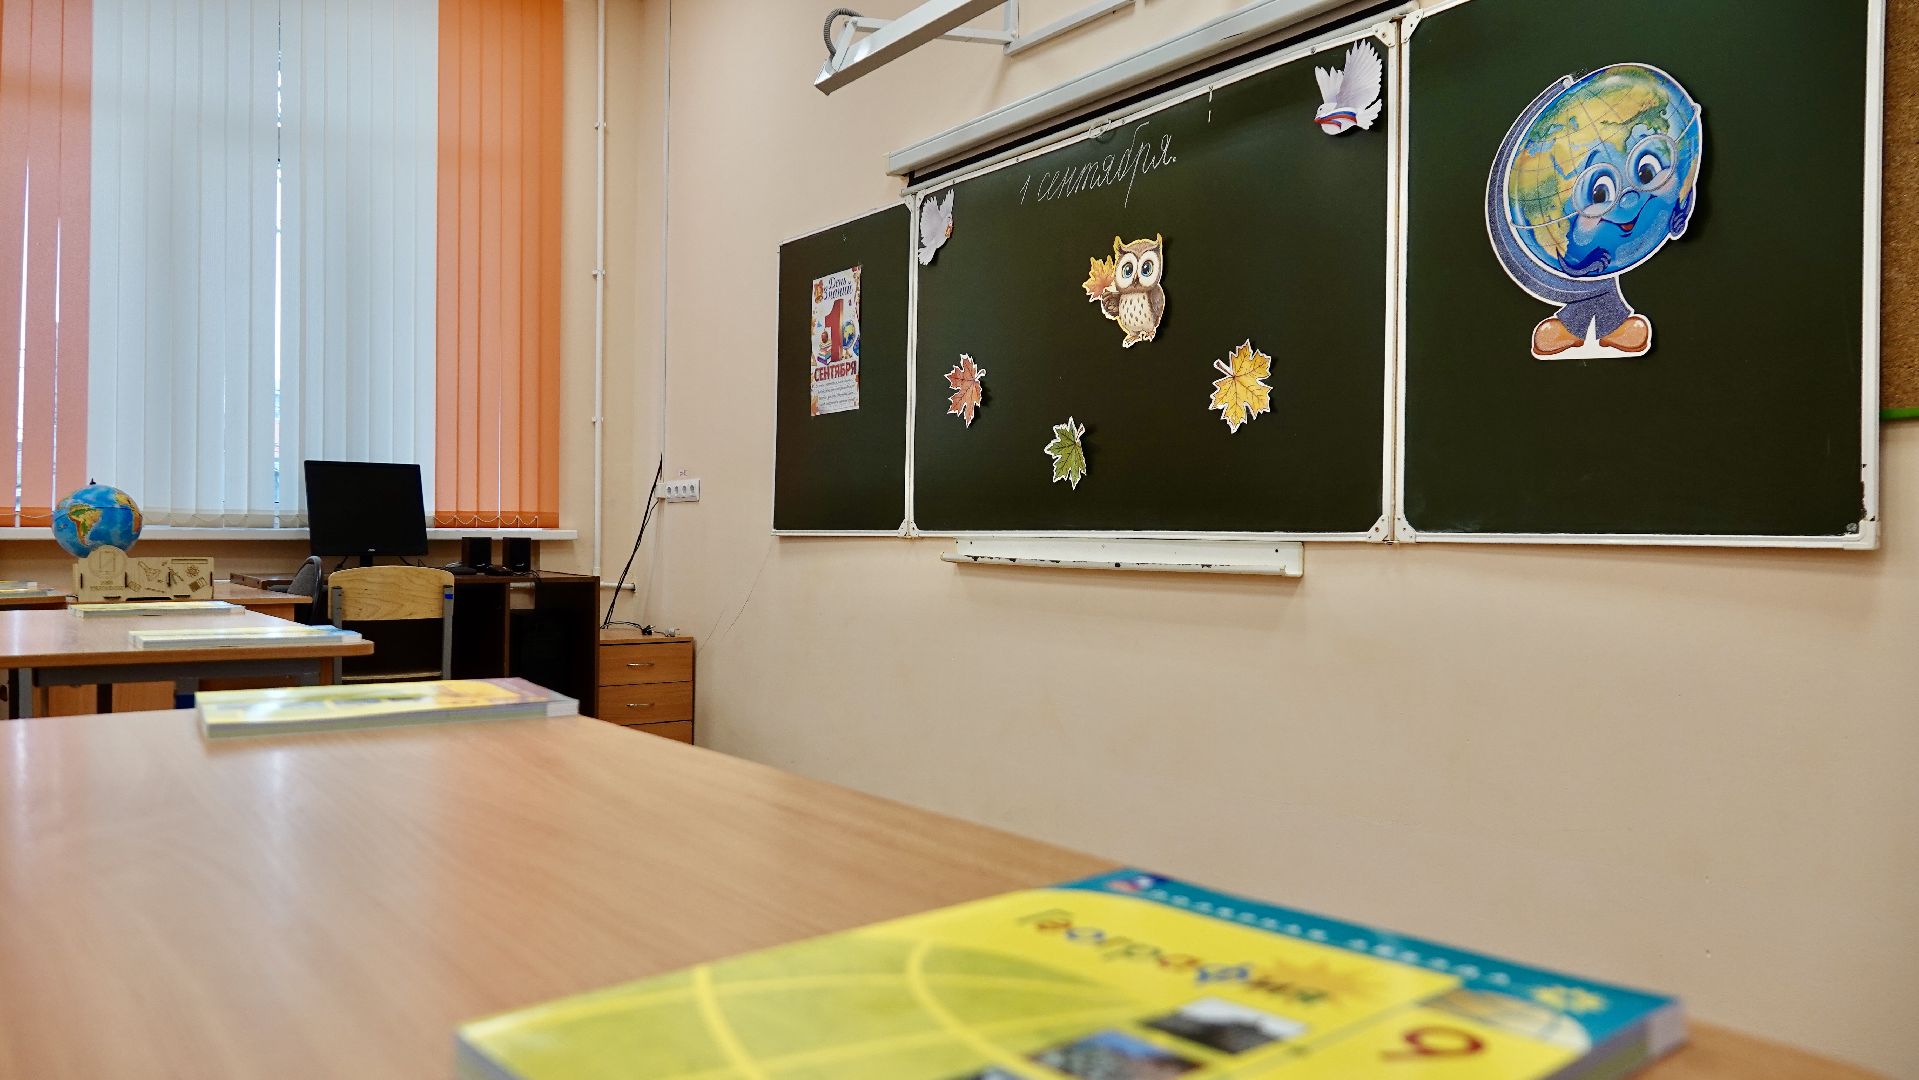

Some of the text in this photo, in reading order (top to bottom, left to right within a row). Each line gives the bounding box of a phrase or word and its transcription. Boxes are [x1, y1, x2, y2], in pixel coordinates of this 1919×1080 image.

[1019, 174, 1031, 205] 1
[824, 298, 844, 363] 1
[814, 360, 857, 382] СЕНТЯБРЯ
